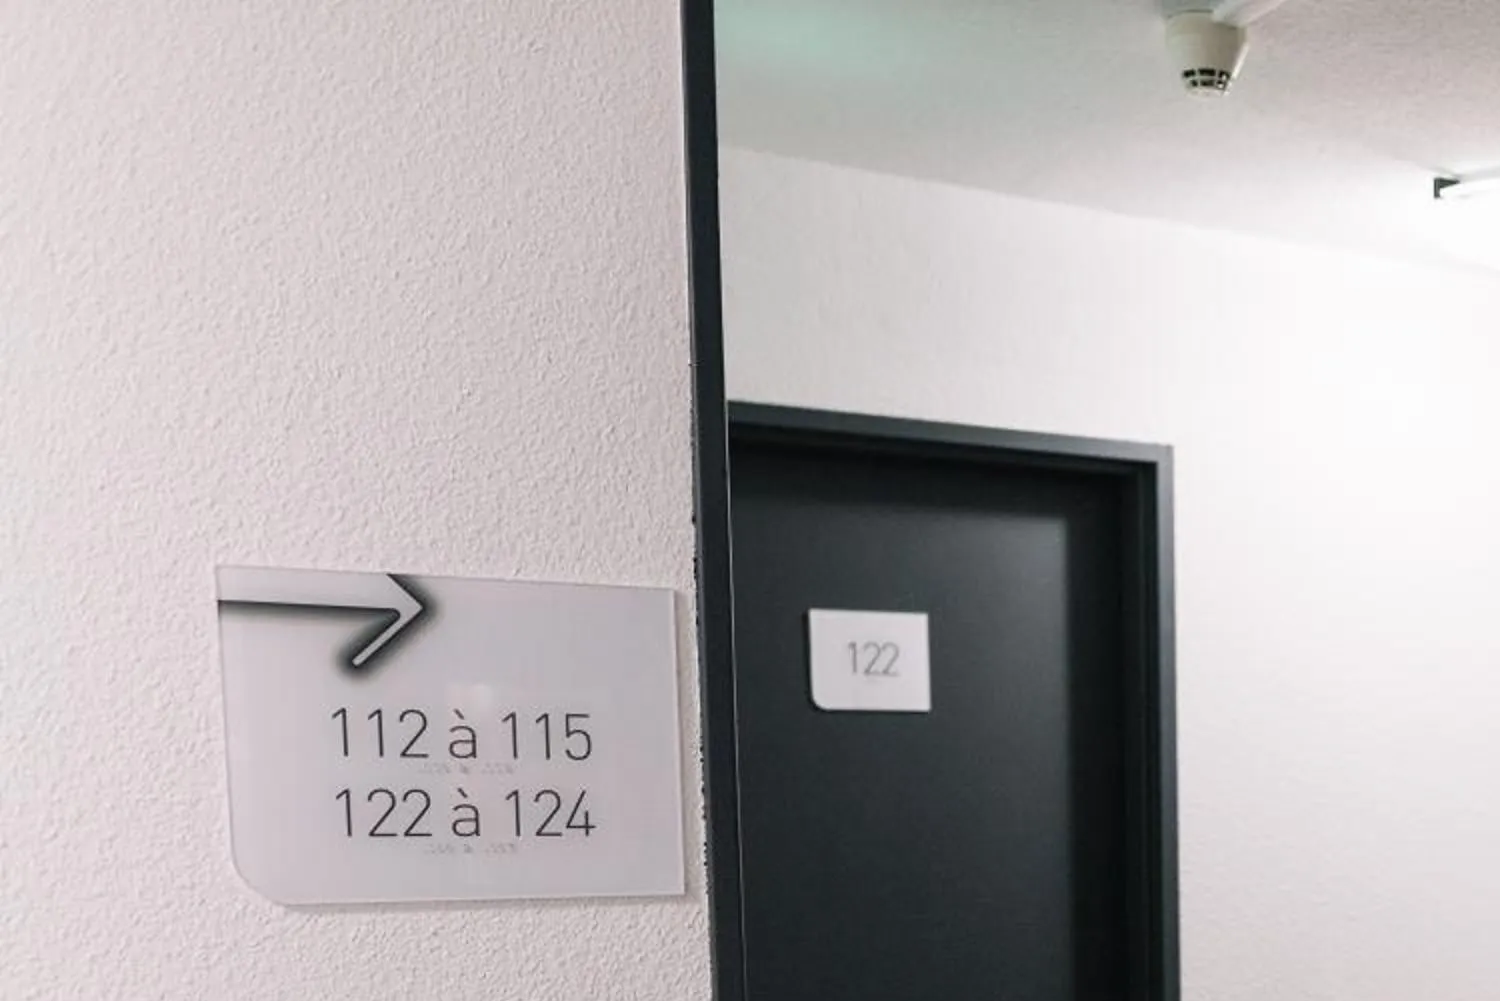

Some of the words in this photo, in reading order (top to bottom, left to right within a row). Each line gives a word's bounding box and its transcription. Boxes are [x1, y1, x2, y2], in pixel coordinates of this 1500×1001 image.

[848, 641, 900, 677] 122
[331, 707, 429, 758] 112
[448, 708, 478, 759] à
[502, 712, 592, 761] 115
[335, 788, 433, 837] 122
[451, 788, 481, 837] à
[505, 789, 597, 837] 124
